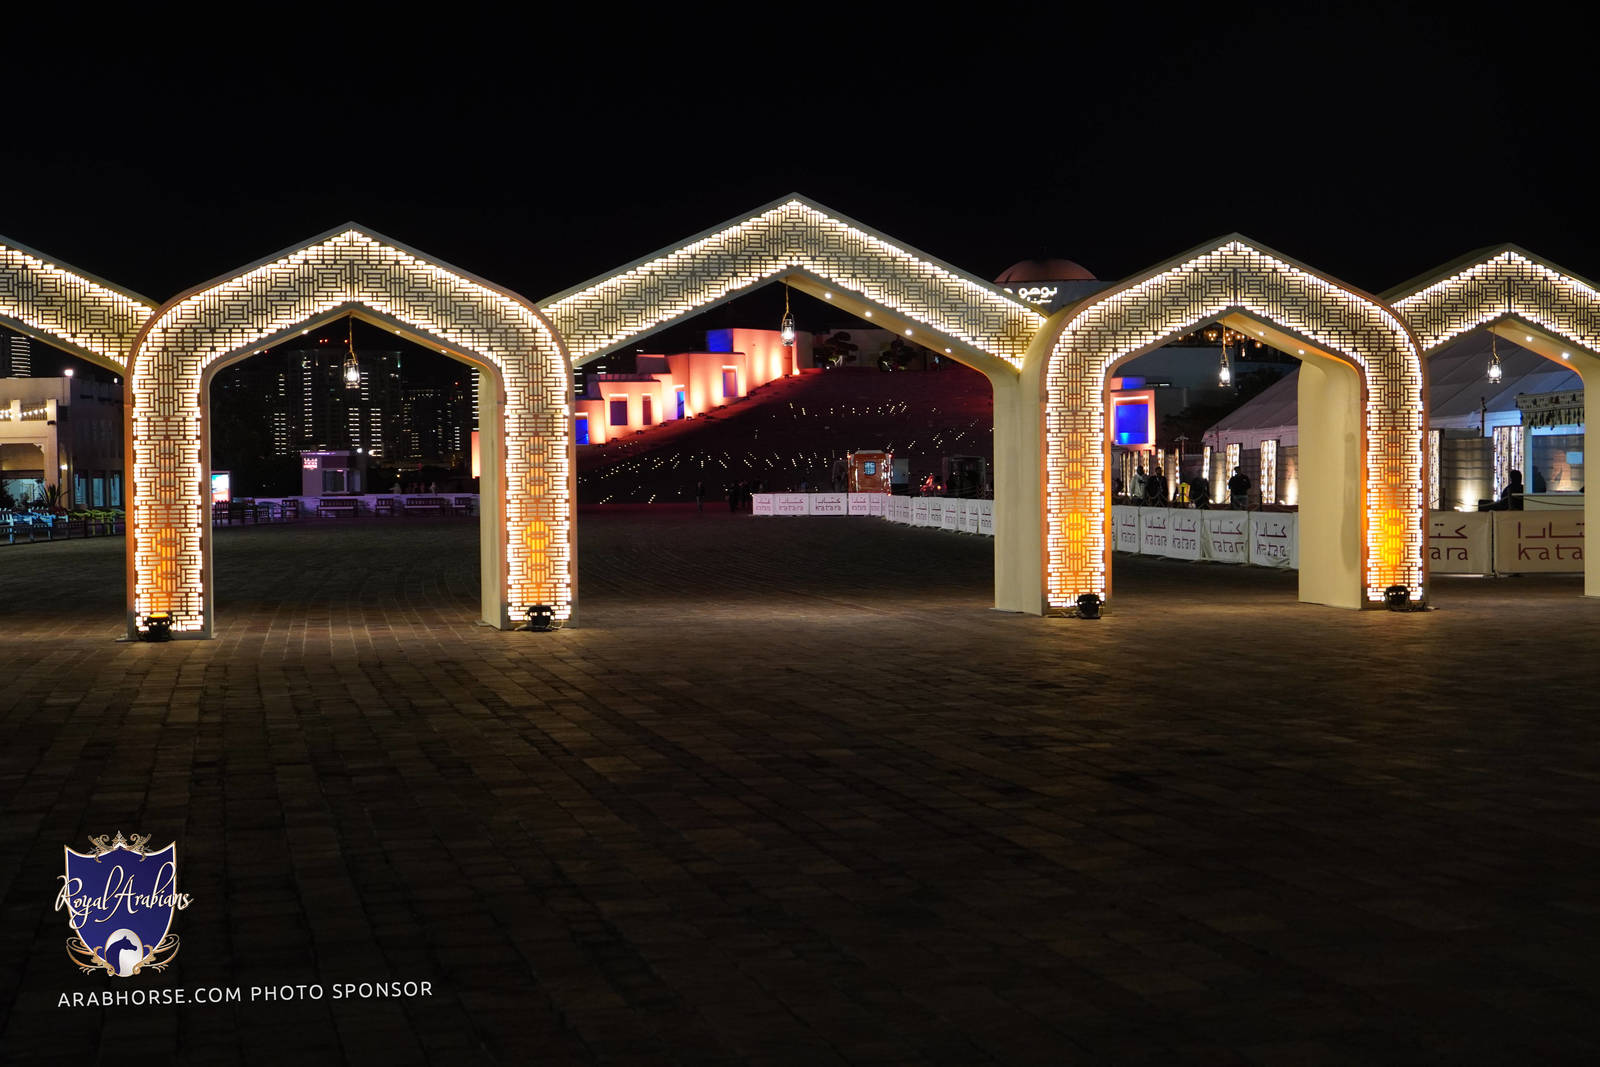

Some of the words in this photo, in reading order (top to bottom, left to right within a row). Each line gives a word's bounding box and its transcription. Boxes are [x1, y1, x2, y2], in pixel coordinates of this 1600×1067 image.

[1517, 521, 1584, 539] تارا
[1429, 546, 1469, 561] ara
[1518, 543, 1584, 561] kata
